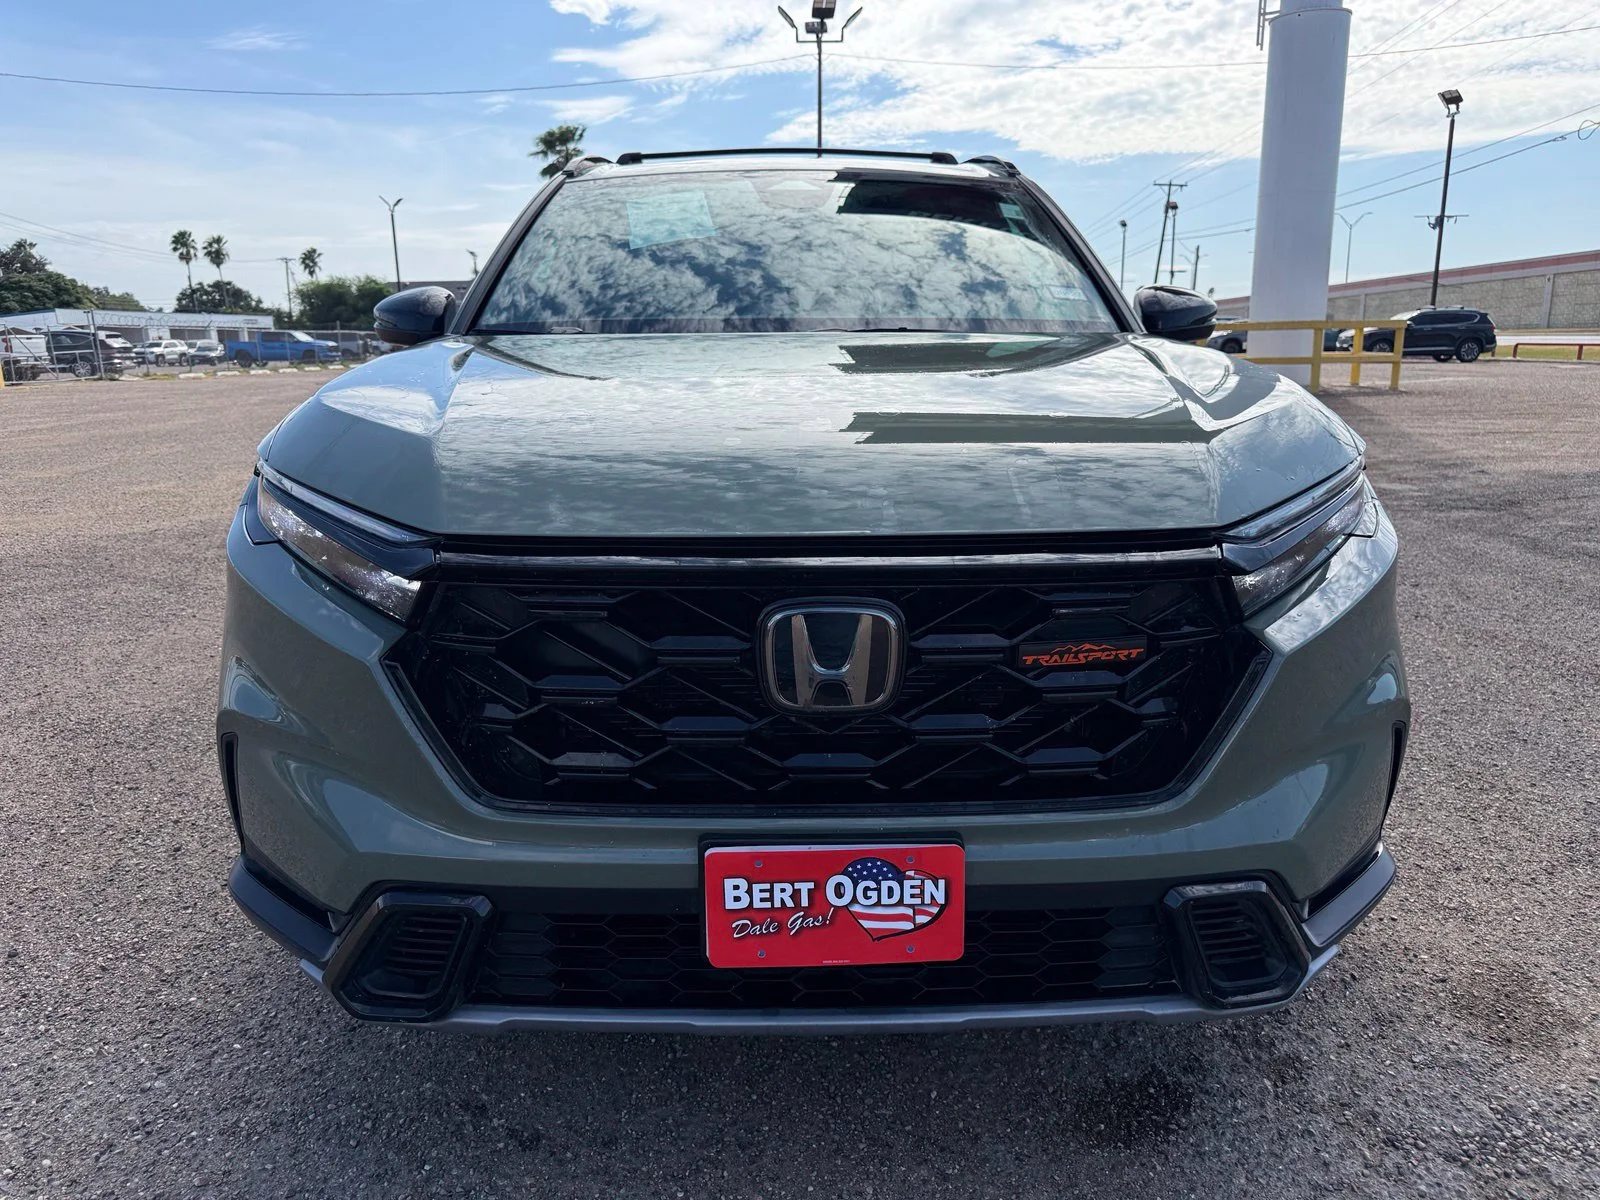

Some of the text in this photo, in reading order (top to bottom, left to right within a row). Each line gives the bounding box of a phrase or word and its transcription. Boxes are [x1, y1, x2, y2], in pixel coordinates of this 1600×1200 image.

[1022, 648, 1144, 666] TRAILSPORT
[723, 875, 946, 910] BERT OGDEN
[731, 907, 834, 938] Dale Gas!
